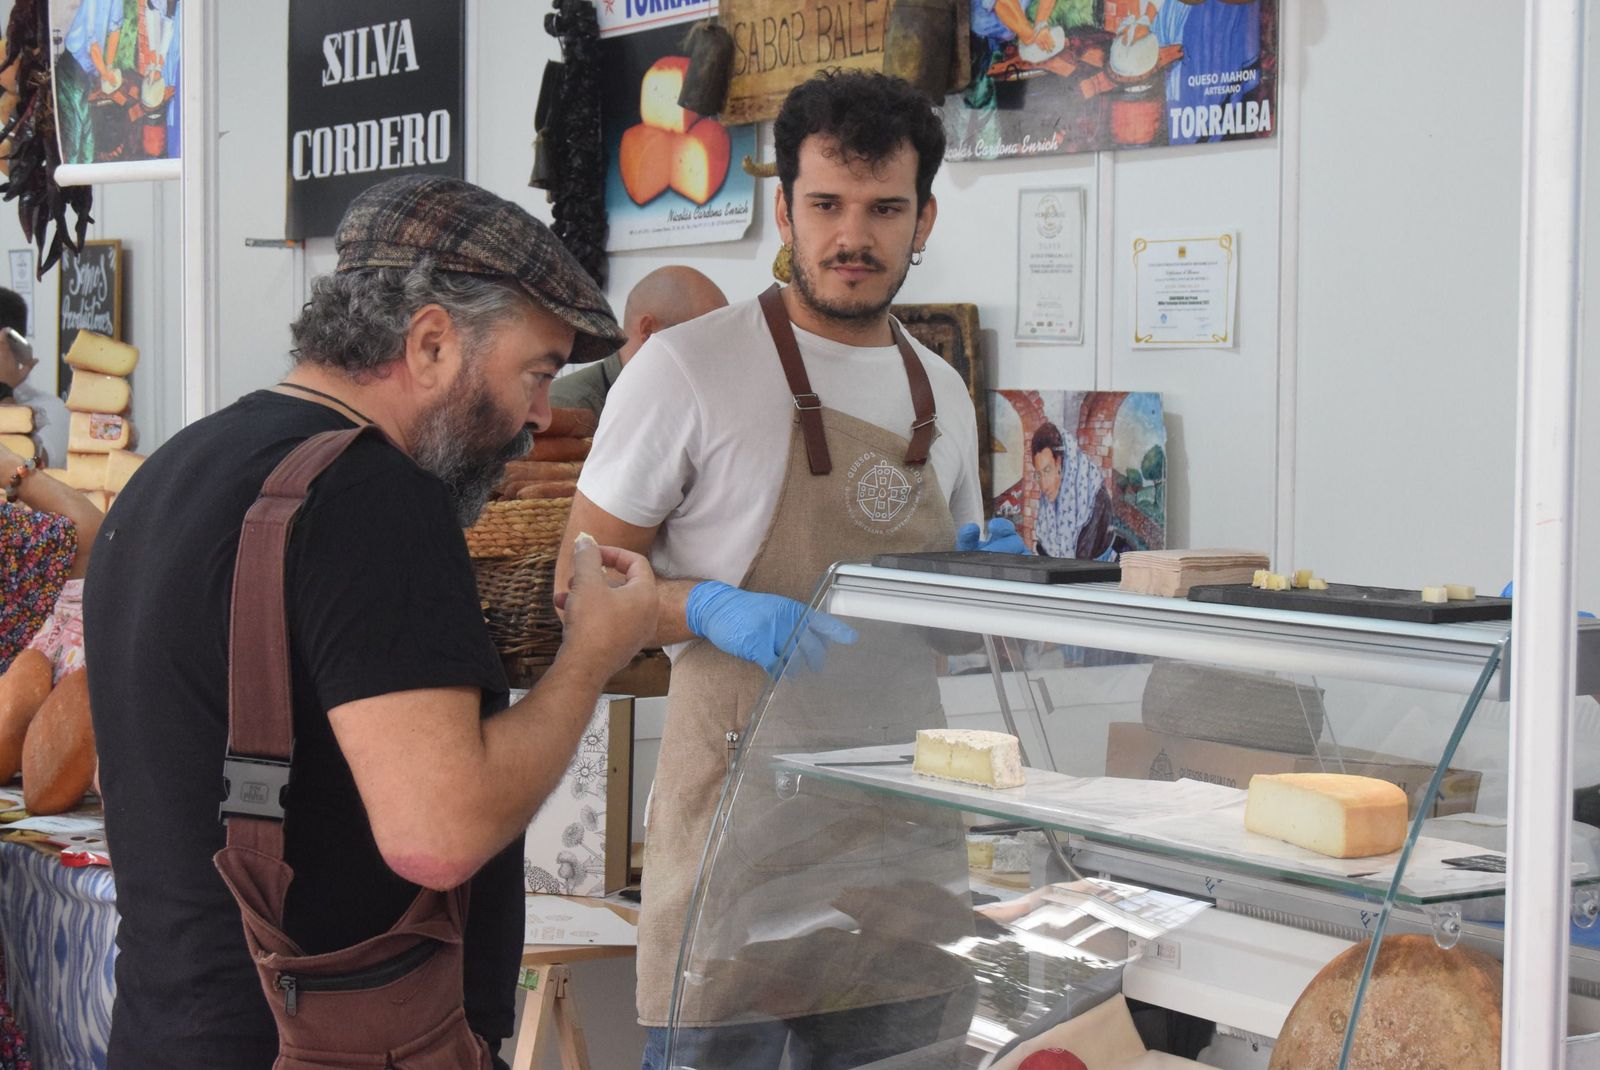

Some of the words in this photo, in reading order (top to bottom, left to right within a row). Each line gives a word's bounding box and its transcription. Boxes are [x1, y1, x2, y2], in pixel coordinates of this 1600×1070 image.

[322, 18, 420, 87] SILVA
[733, 11, 806, 76] SABOR
[816, 0, 890, 63] BALE
[1188, 73, 1219, 87] QUESO
[1221, 69, 1256, 83] MAHON
[1204, 84, 1241, 96] ARTESANO
[1170, 99, 1271, 139] TORRALBA
[292, 109, 451, 181] CORDERO
[975, 138, 1018, 157] Cardona
[1022, 132, 1058, 153] Enrich
